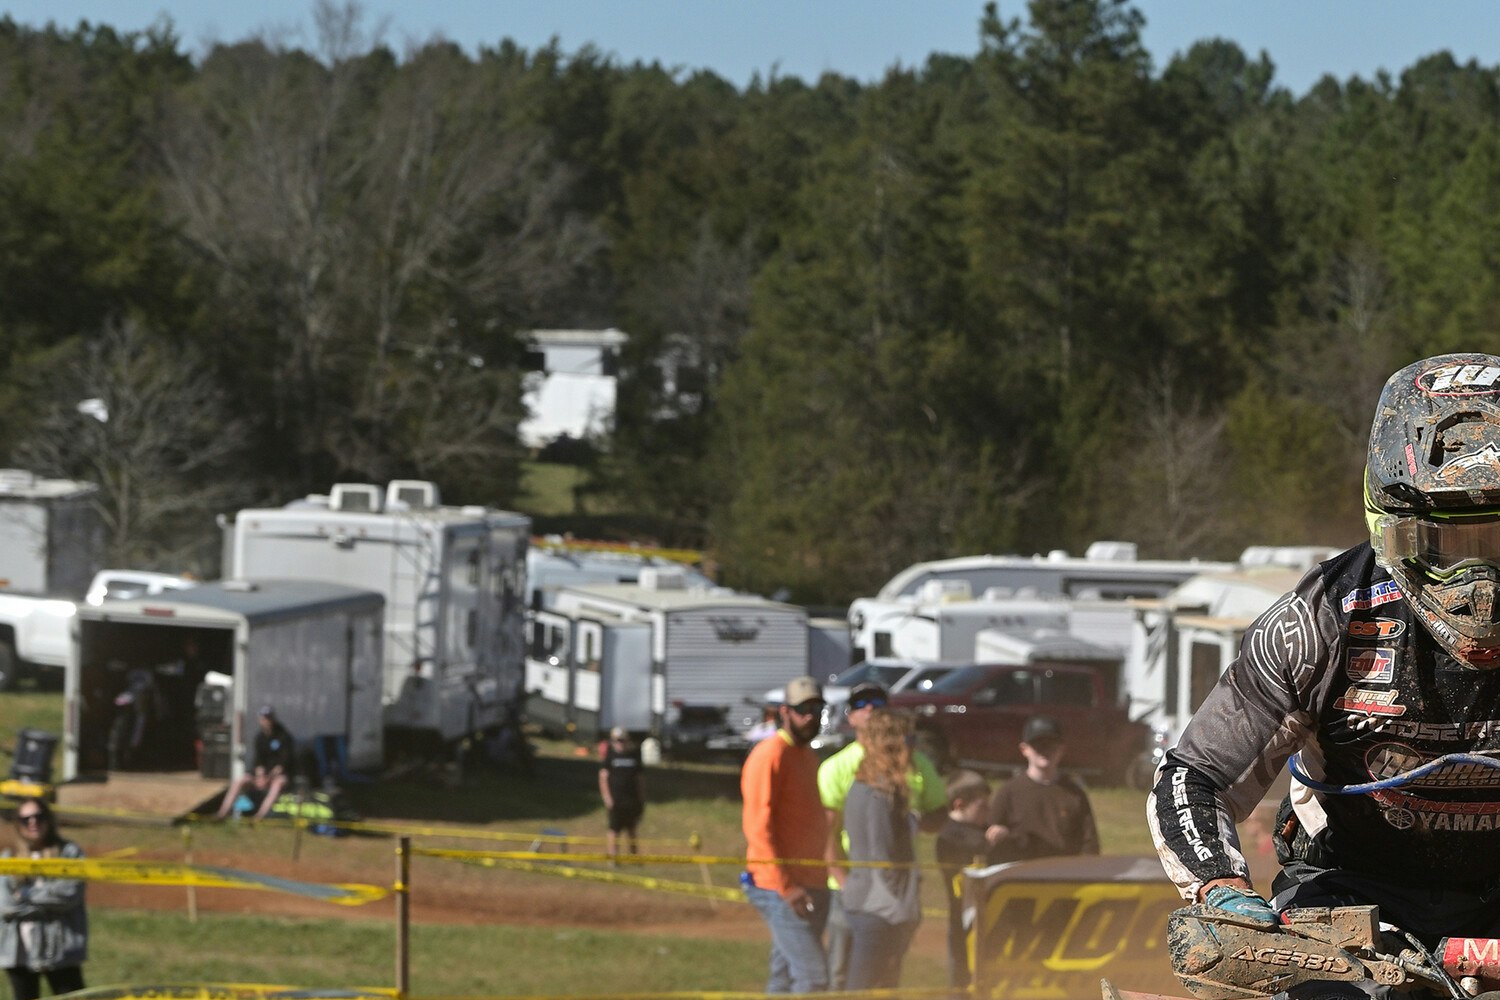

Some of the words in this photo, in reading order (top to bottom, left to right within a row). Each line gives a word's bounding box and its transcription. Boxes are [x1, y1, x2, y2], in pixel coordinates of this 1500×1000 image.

[1350, 620, 1396, 636] CST
[1177, 808, 1213, 862] RACING
[1230, 944, 1353, 974] ACERBIS
